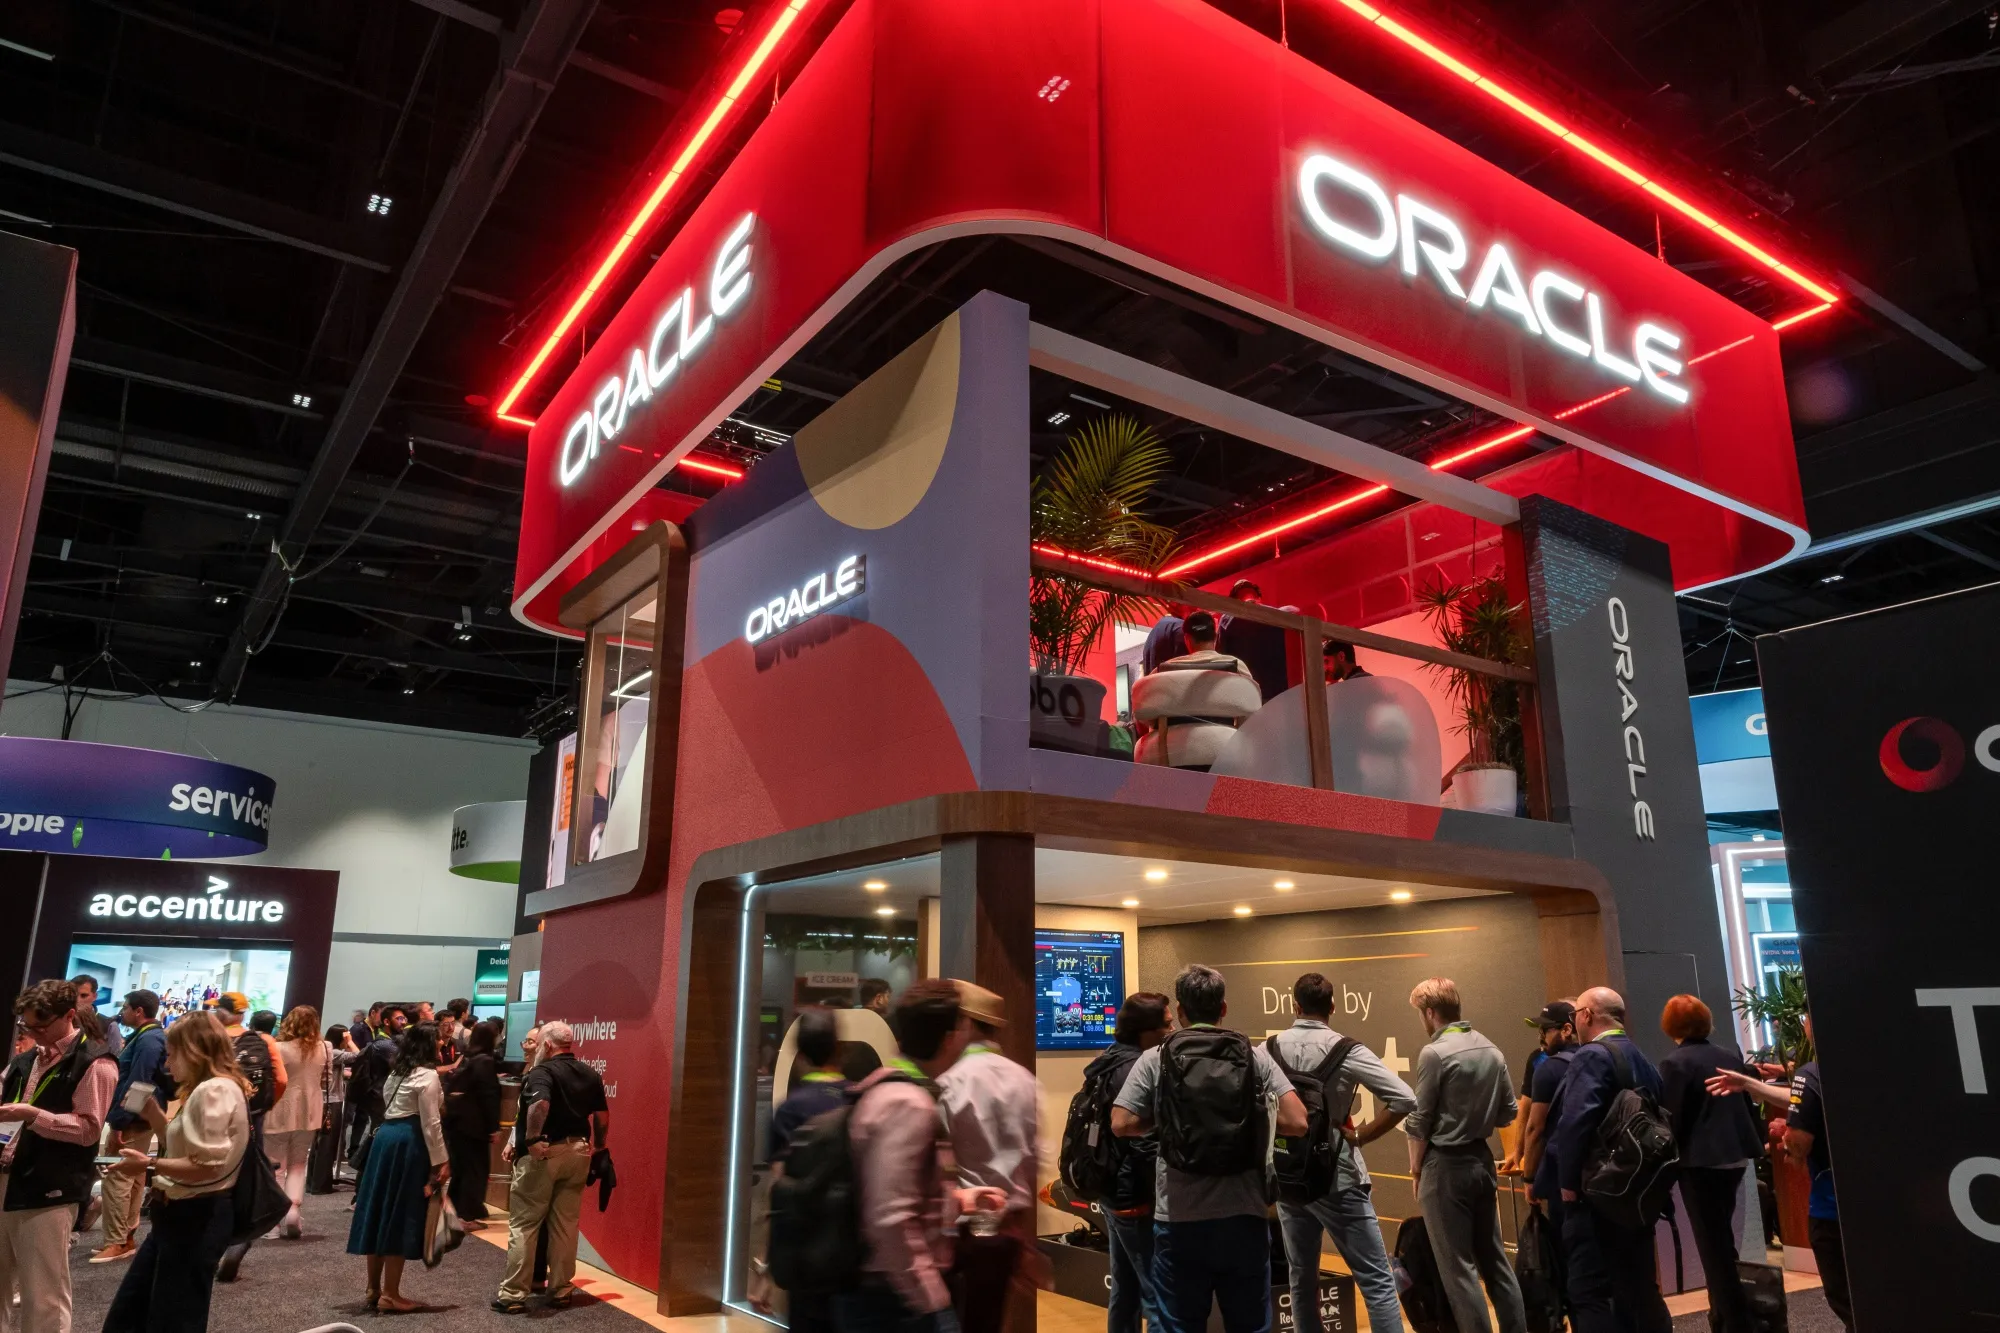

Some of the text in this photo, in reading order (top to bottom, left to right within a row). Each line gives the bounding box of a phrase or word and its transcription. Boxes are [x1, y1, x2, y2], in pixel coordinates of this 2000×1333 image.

[1299, 154, 1689, 404] ORACLE
[560, 211, 755, 487] ORACLE
[745, 555, 858, 642] ORACLE
[1608, 597, 1655, 840] ORACLE
[169, 783, 272, 831] service
[90, 892, 284, 923] accenture
[490, 957, 509, 965] Deloi
[1343, 983, 1372, 1021] by
[572, 1016, 617, 1047] nywhere
